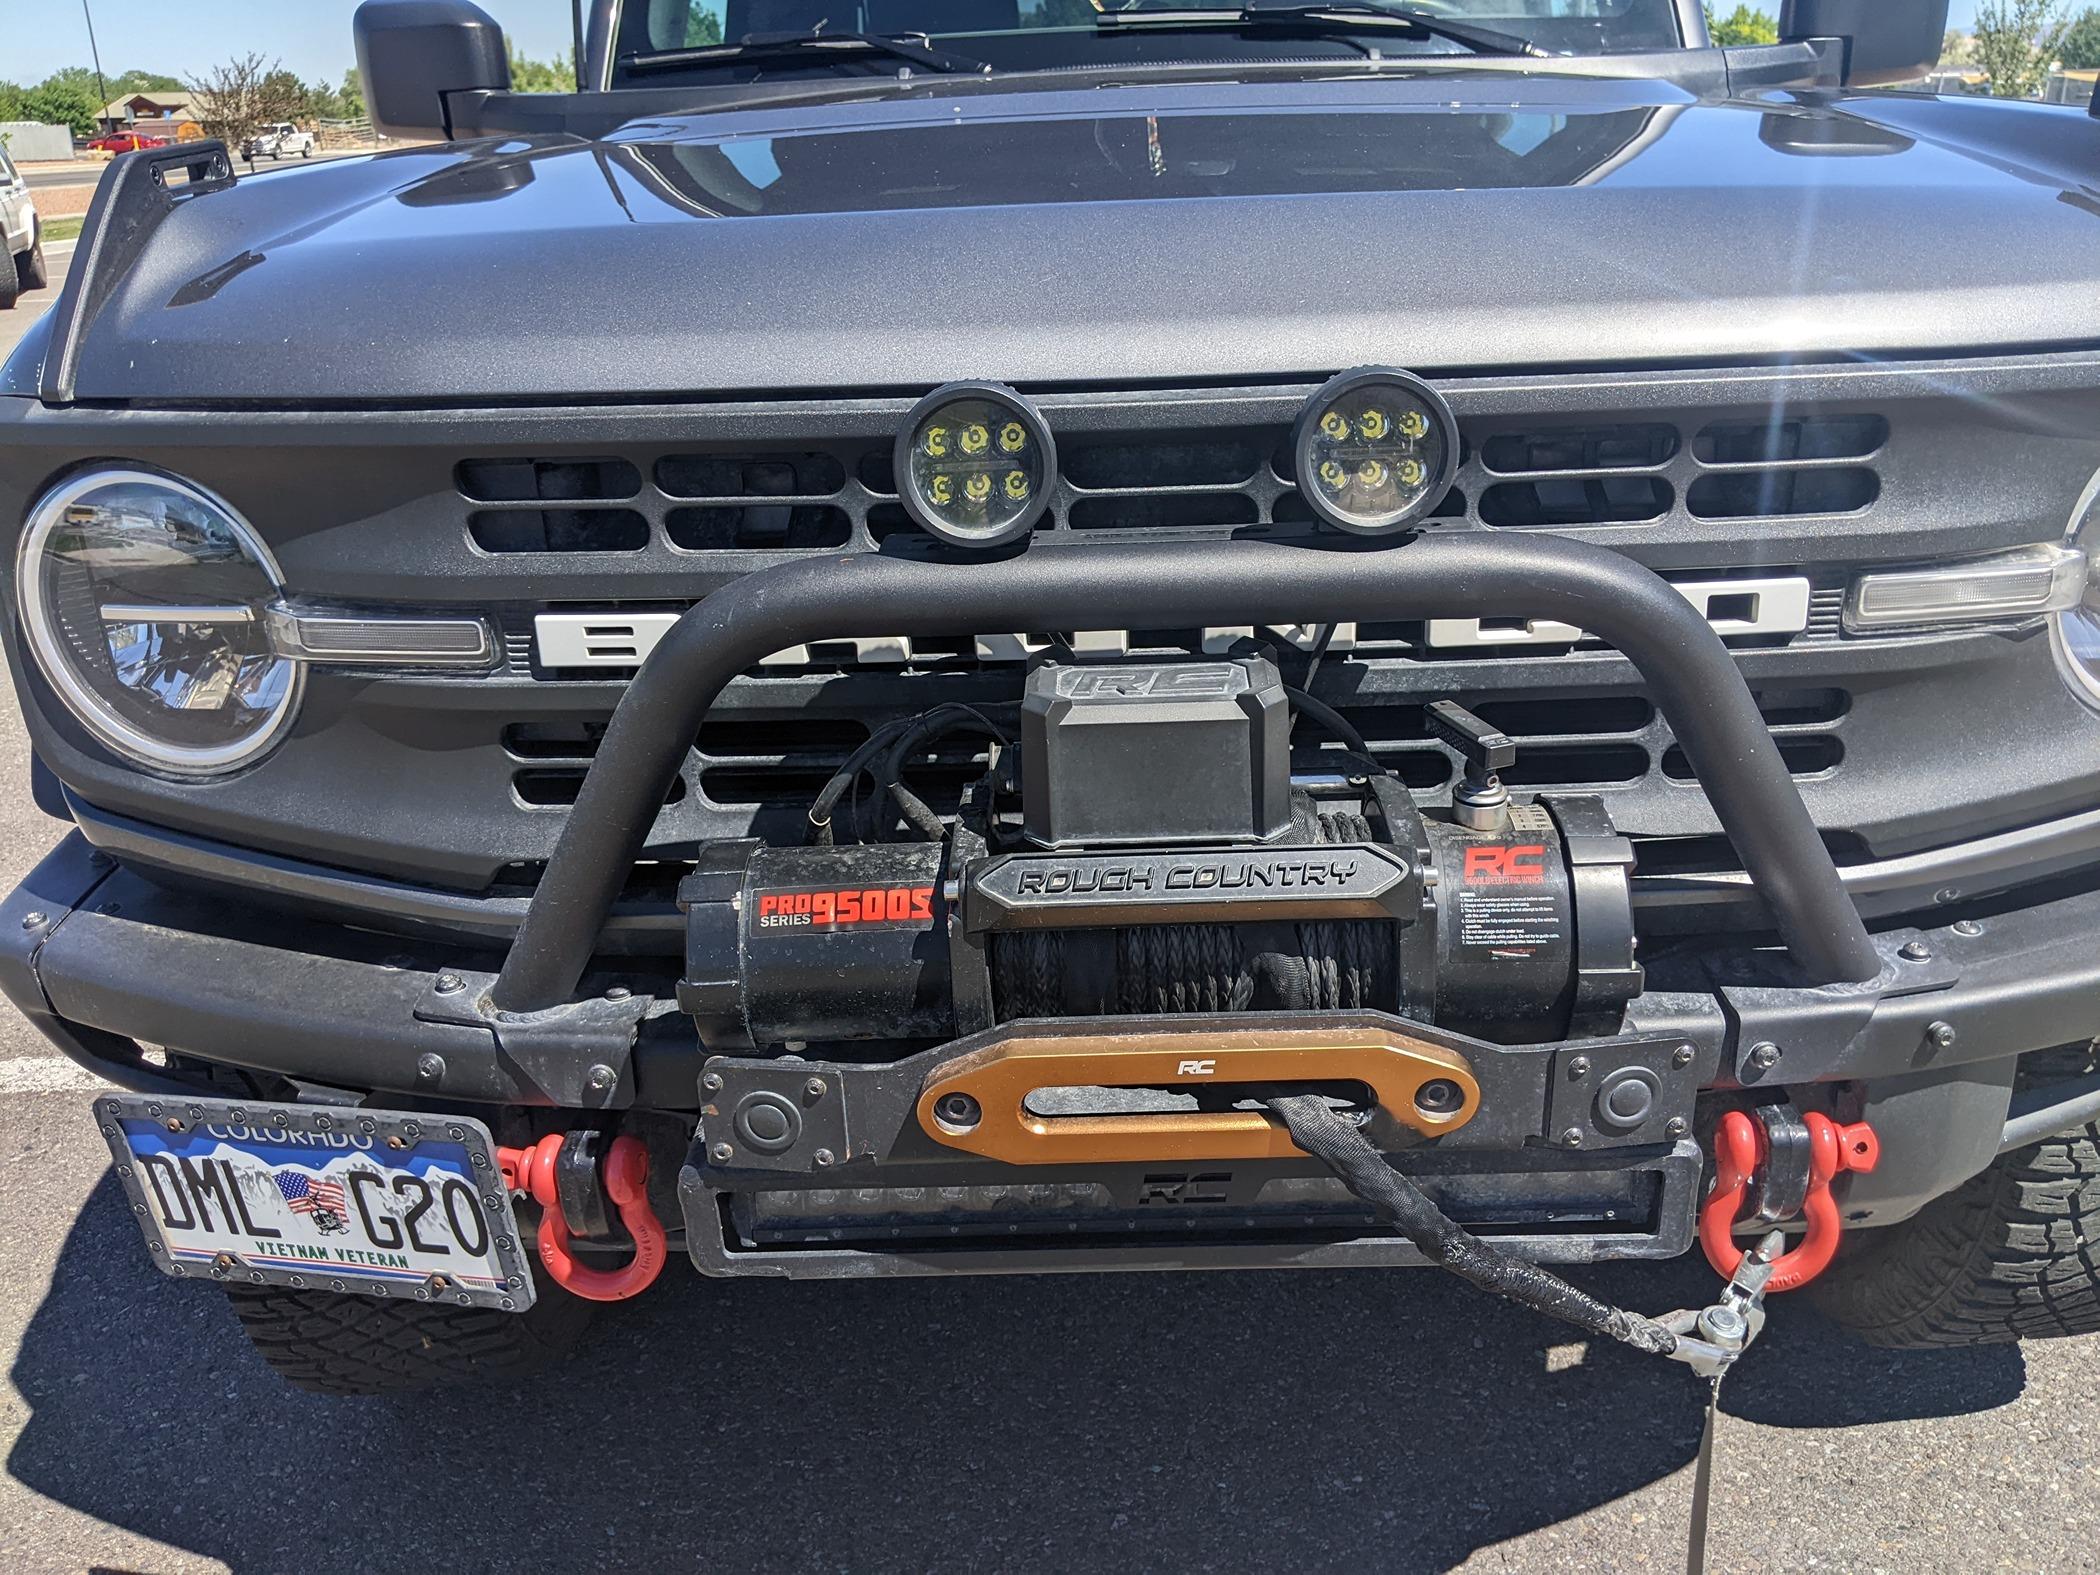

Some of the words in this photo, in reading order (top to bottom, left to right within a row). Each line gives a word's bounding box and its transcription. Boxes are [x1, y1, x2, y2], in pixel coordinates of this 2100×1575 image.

[1071, 666, 1234, 697] RC
[1464, 845, 1545, 876] RC
[1017, 866, 1156, 895] ROUGH
[1164, 859, 1358, 890] COUNTRY
[759, 894, 812, 915] PRO
[812, 887, 934, 925] 9500S
[759, 914, 811, 928] SERIES
[1177, 1059, 1216, 1075] RC
[1139, 1172, 1233, 1204] RC
[138, 1153, 282, 1239] DML
[348, 1170, 490, 1258] G20
[255, 1241, 328, 1262] VIETNAM
[335, 1249, 410, 1270] VETERAN
